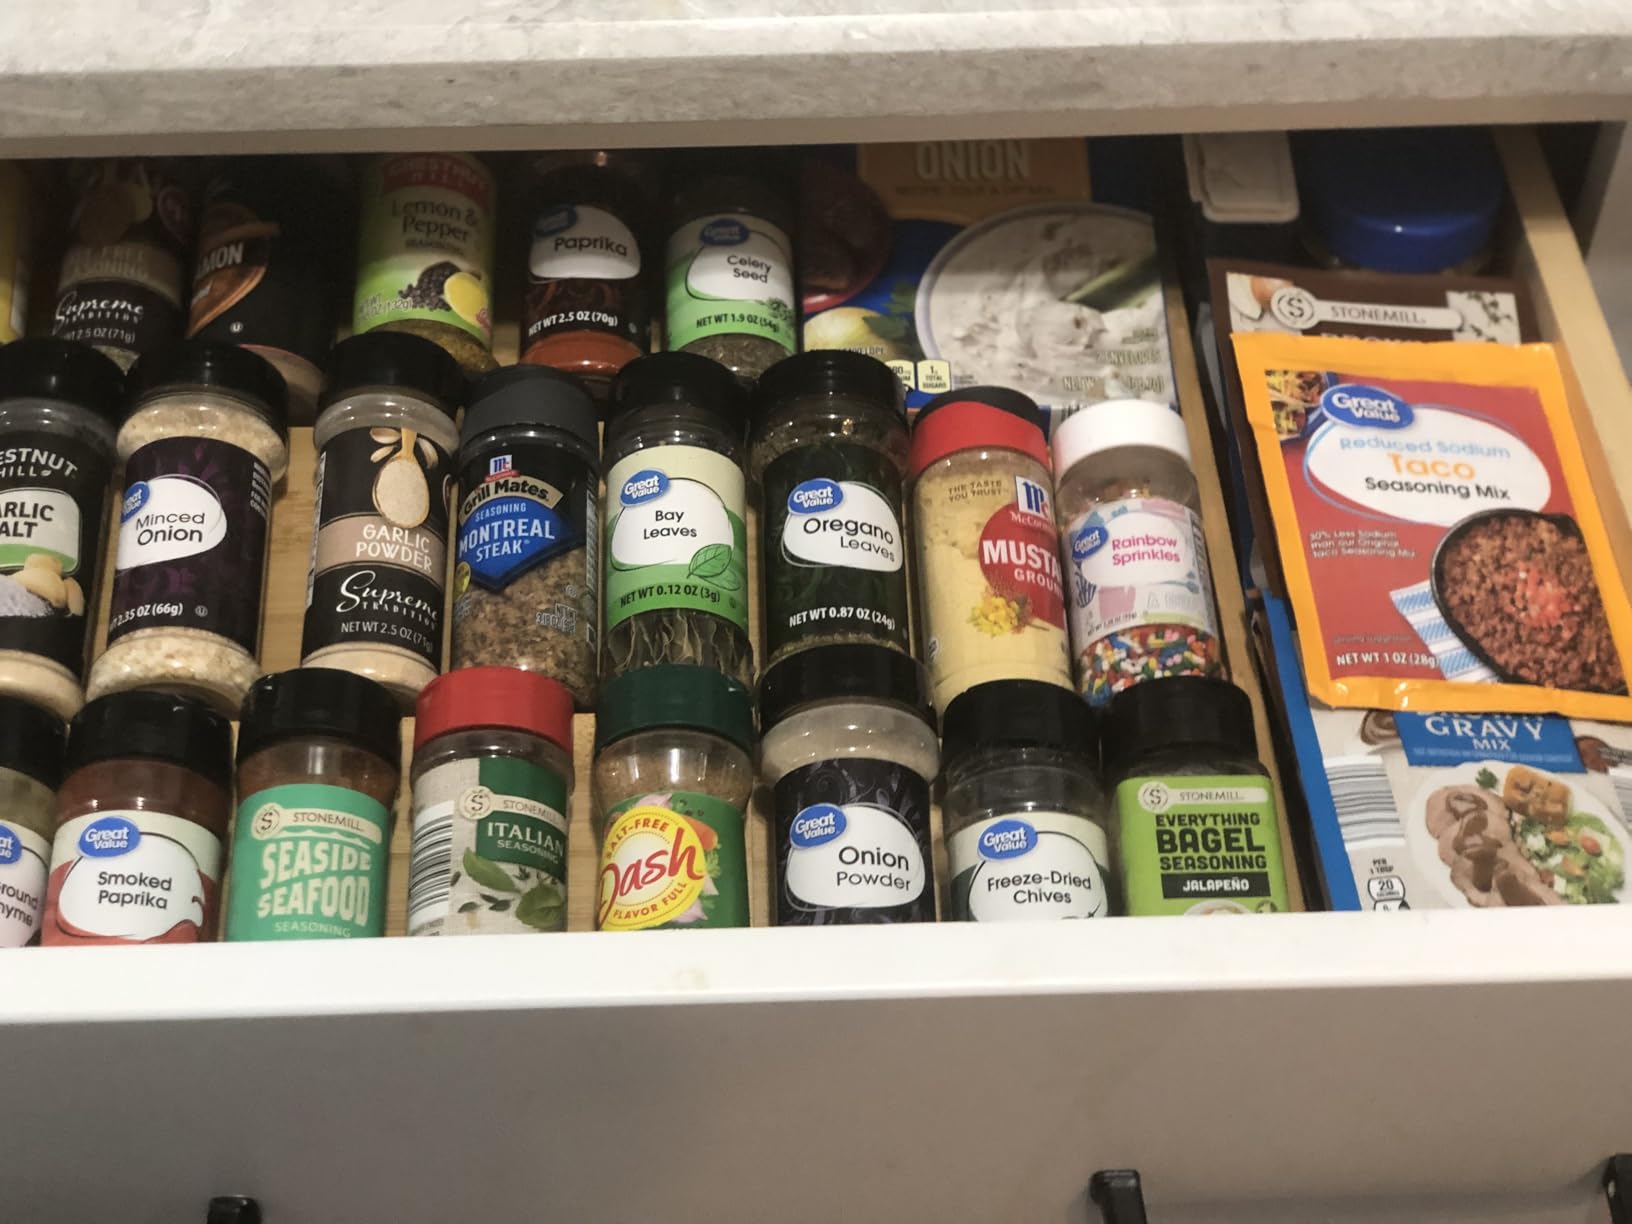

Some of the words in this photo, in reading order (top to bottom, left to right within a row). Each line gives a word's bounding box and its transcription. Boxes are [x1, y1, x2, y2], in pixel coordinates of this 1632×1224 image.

[916, 141, 1029, 180] ONION
[392, 200, 461, 219] Lemon
[403, 216, 468, 241] Pepper
[554, 237, 627, 256] Paprika
[727, 255, 771, 274] Celery
[733, 268, 768, 283] Seed
[52, 291, 144, 336] Supreme
[697, 316, 712, 328] NET
[714, 313, 728, 324] WT
[731, 313, 745, 323] 1.9
[746, 314, 758, 324] OZ
[1331, 306, 1422, 324] STONEMILL
[528, 321, 542, 337] NET
[542, 314, 558, 328] WT
[558, 311, 575, 324] 2.5
[575, 310, 591, 321] OZ
[591, 311, 618, 327] (70g)
[93, 328, 106, 337] OZ
[107, 329, 136, 345] (71g)
[1332, 393, 1395, 411] Great
[1350, 406, 1400, 423] Value
[1340, 436, 1432, 453] Reduced
[1437, 441, 1511, 459] Sodium
[1387, 452, 1475, 480] Taco
[625, 475, 659, 495] Great
[632, 487, 660, 499] Value
[793, 485, 833, 502] Great
[949, 483, 967, 495] THE
[970, 480, 1002, 488] TASTE
[1365, 476, 1471, 499] Seasoning
[1475, 484, 1511, 500] Mix
[464, 485, 490, 515] Grill
[495, 479, 549, 499] Mates
[803, 496, 833, 508] Value
[949, 494, 968, 502] YOU
[972, 488, 1001, 497] TRUST
[0, 501, 54, 522] RLIC
[136, 511, 205, 530] Minced
[475, 503, 527, 522] SEASONING
[655, 510, 684, 524] Bay
[137, 526, 202, 546] Onion
[363, 524, 431, 553] GARLIC
[459, 518, 555, 558] MONTREAL
[643, 526, 697, 540] Leaves
[803, 518, 894, 545] Oregano
[476, 540, 522, 562] STEAK
[840, 536, 895, 563] Leaves
[1112, 534, 1177, 551] Rainbow
[356, 541, 433, 574] POWDER
[1112, 549, 1181, 566] Sprinkles
[336, 569, 437, 620] Supreme
[620, 591, 636, 608] NET
[638, 586, 655, 599] WT
[656, 585, 682, 597] 0.12
[683, 585, 698, 597] OZ
[700, 588, 720, 604] (3g)
[118, 608, 136, 627] 2.35
[137, 604, 151, 618] OZ
[152, 602, 184, 617] (66g)
[789, 613, 808, 628] NET
[809, 607, 827, 621] WT
[829, 606, 854, 619] 0.87
[856, 607, 871, 620] OZ
[871, 611, 896, 631] (24g)
[341, 621, 360, 633] NET
[362, 621, 379, 632] WT
[380, 622, 397, 636] 2.5
[400, 626, 413, 640] OZ
[1336, 652, 1358, 666] NET
[1361, 651, 1380, 662] WT
[1392, 652, 1408, 664] OZ
[1410, 652, 1439, 669] (28g)
[1425, 716, 1543, 741] GRAVY
[1472, 738, 1511, 752] MIX
[1179, 791, 1242, 801] STONEMILL
[293, 812, 362, 831] STONEMILL
[795, 814, 835, 834] Great
[1155, 812, 1260, 827] EVERYTHING
[85, 826, 129, 842] Great
[487, 822, 564, 857] ITALIAN
[606, 818, 669, 858] SALT-FREE
[804, 825, 836, 840] Value
[983, 827, 1027, 847] Great
[1156, 828, 1266, 853] BAGEL
[94, 838, 128, 850] Value
[994, 838, 1027, 853] Value
[260, 840, 371, 889] SEASIDE
[839, 846, 909, 871] Onion
[1160, 855, 1267, 871] SEASONING
[98, 871, 172, 892] Smoked
[837, 871, 911, 891] Powder
[988, 871, 1092, 892] Freeze-Dried
[1182, 876, 1249, 892] JALAPEÑO
[1378, 879, 1394, 891] 20
[98, 890, 168, 910] Paprika
[257, 875, 370, 927] SEAFOOD
[662, 882, 687, 906] FULL
[1013, 889, 1071, 904] Chives
[613, 904, 658, 919] FLAVOR
[274, 921, 351, 938] SEASONING
